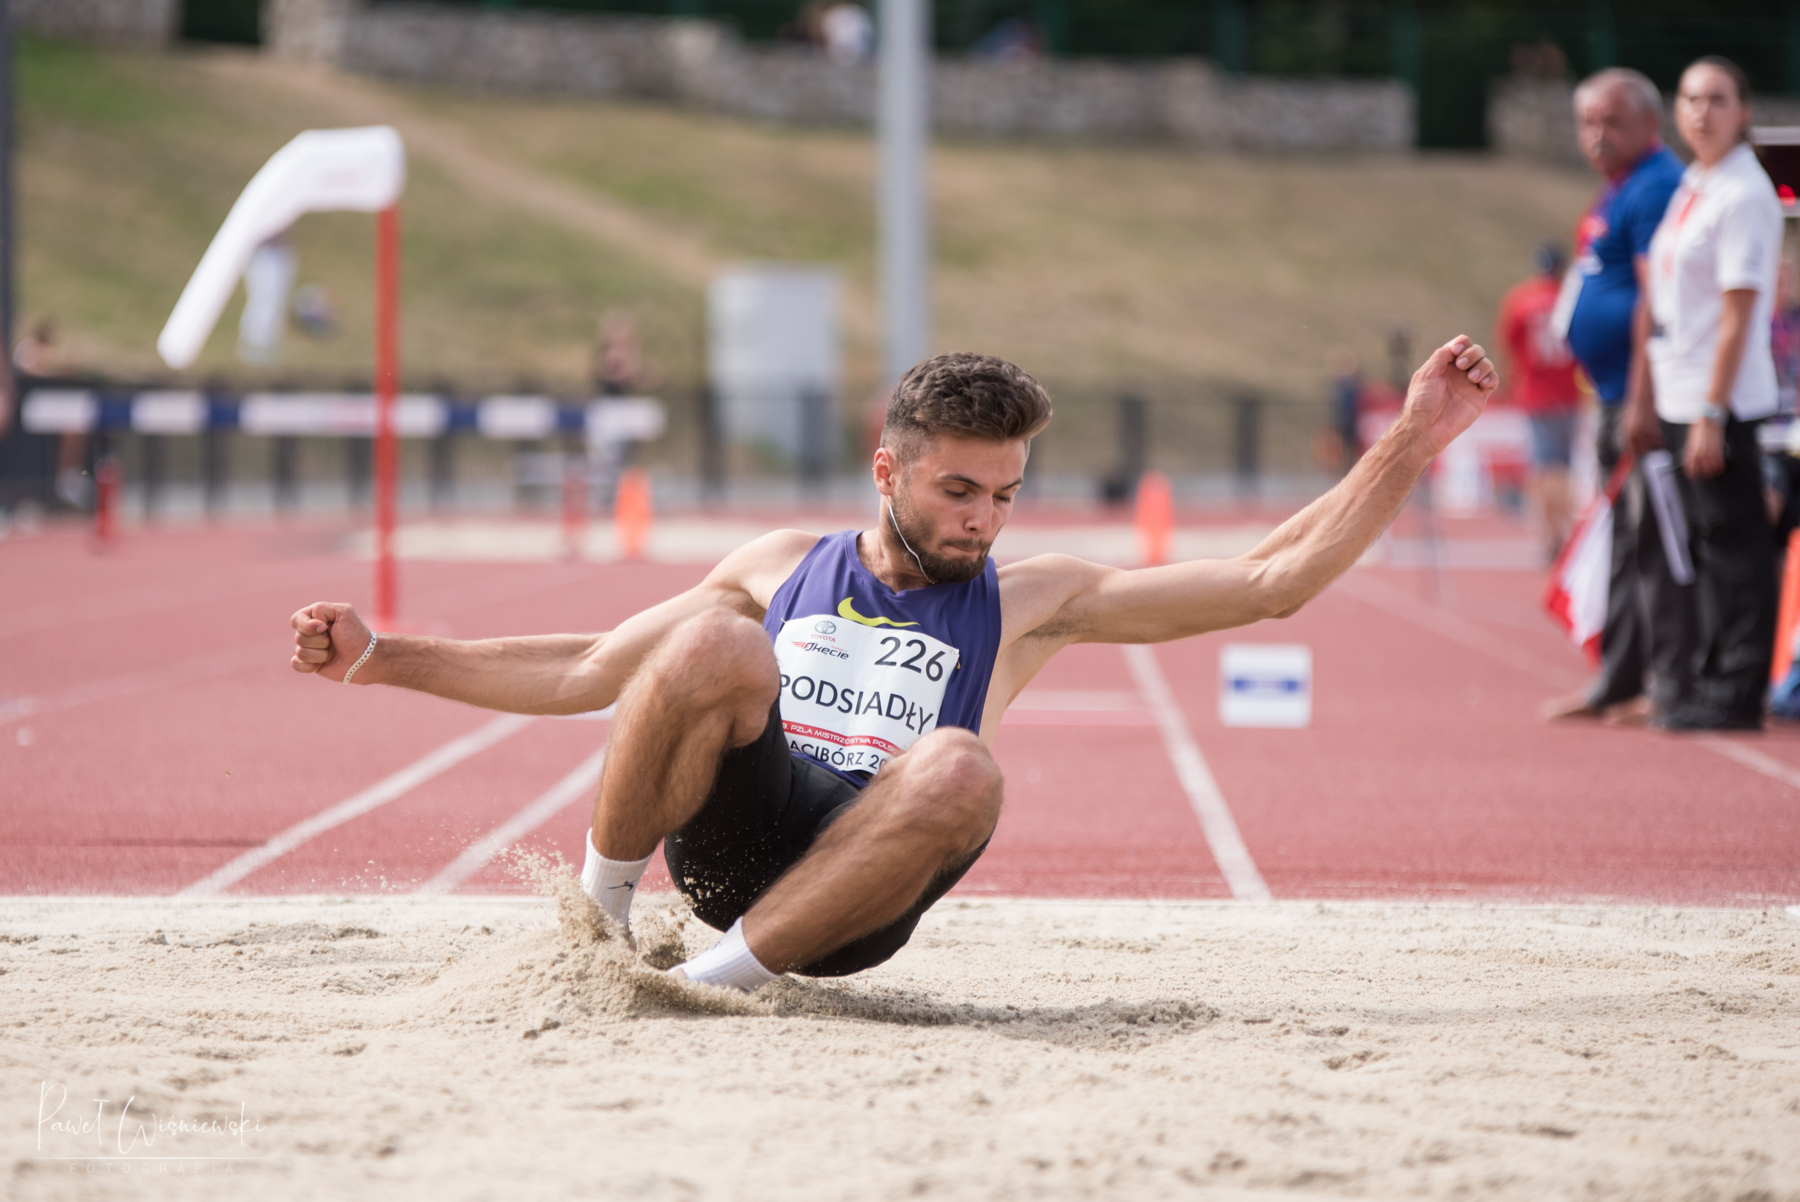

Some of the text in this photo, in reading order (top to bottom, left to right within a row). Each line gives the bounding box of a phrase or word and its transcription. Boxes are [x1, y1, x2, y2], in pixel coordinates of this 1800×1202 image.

[811, 634, 836, 643] TOYOTA
[874, 636, 946, 682] 226
[790, 724, 813, 735] PZLA
[814, 730, 871, 745] MISTRZOSTWA
[790, 740, 865, 767] ACIBÓRZ
